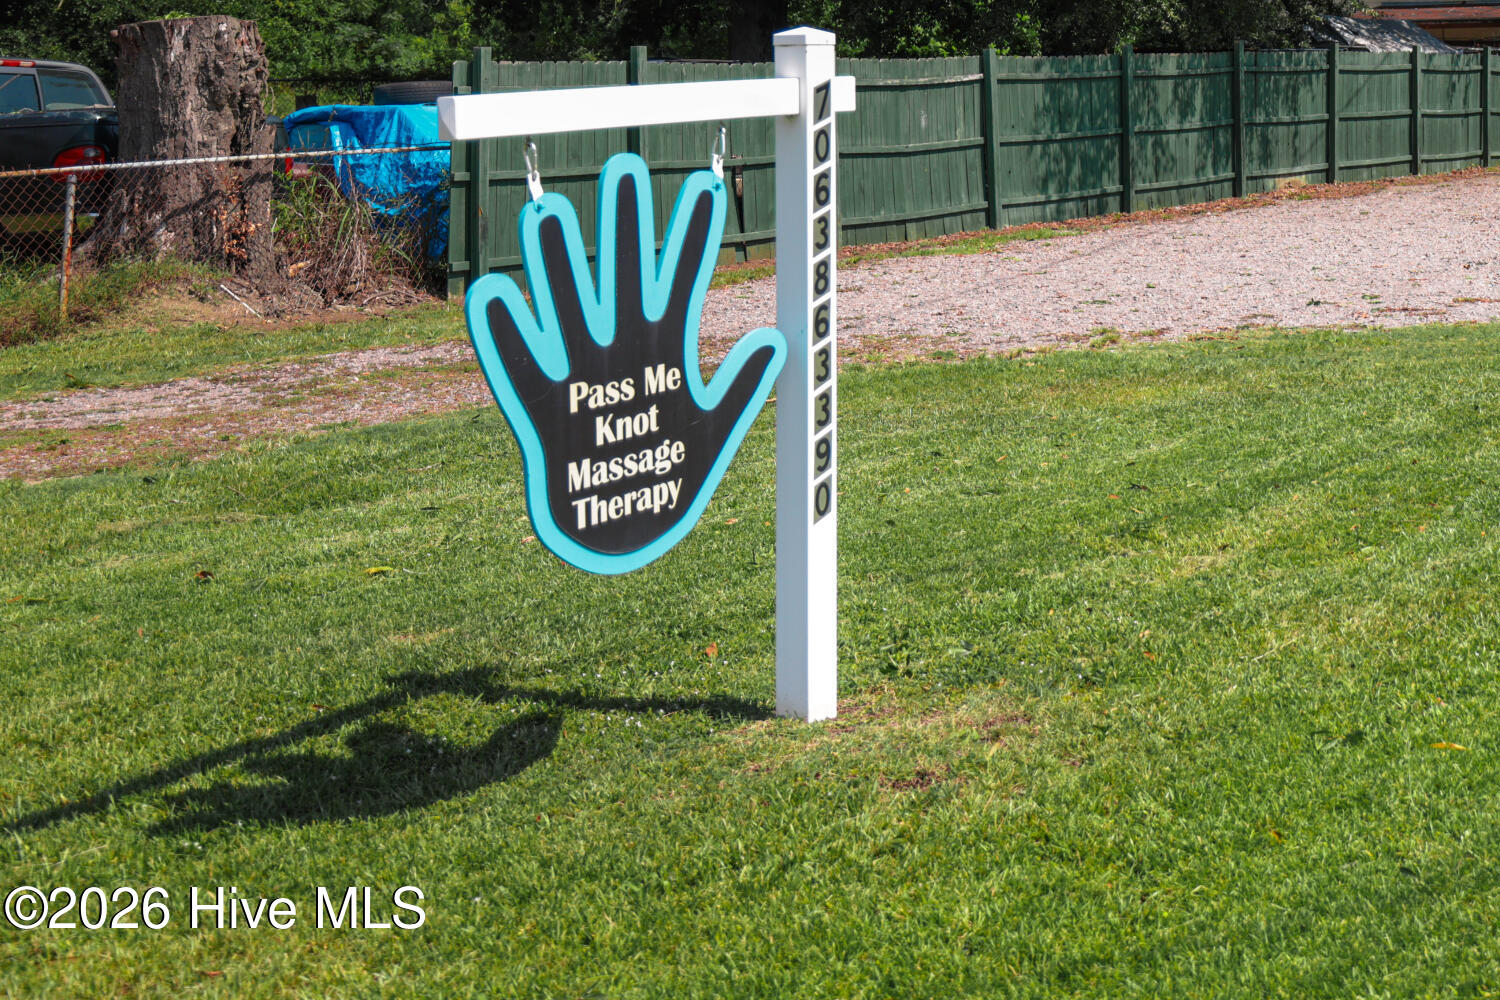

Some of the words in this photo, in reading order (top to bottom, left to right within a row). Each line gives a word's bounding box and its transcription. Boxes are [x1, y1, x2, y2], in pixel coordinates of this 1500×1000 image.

[569, 377, 635, 414] Pass
[644, 363, 681, 396] Me
[595, 403, 660, 446] Knot
[568, 439, 686, 493] Massage
[571, 478, 683, 530] Therapy
